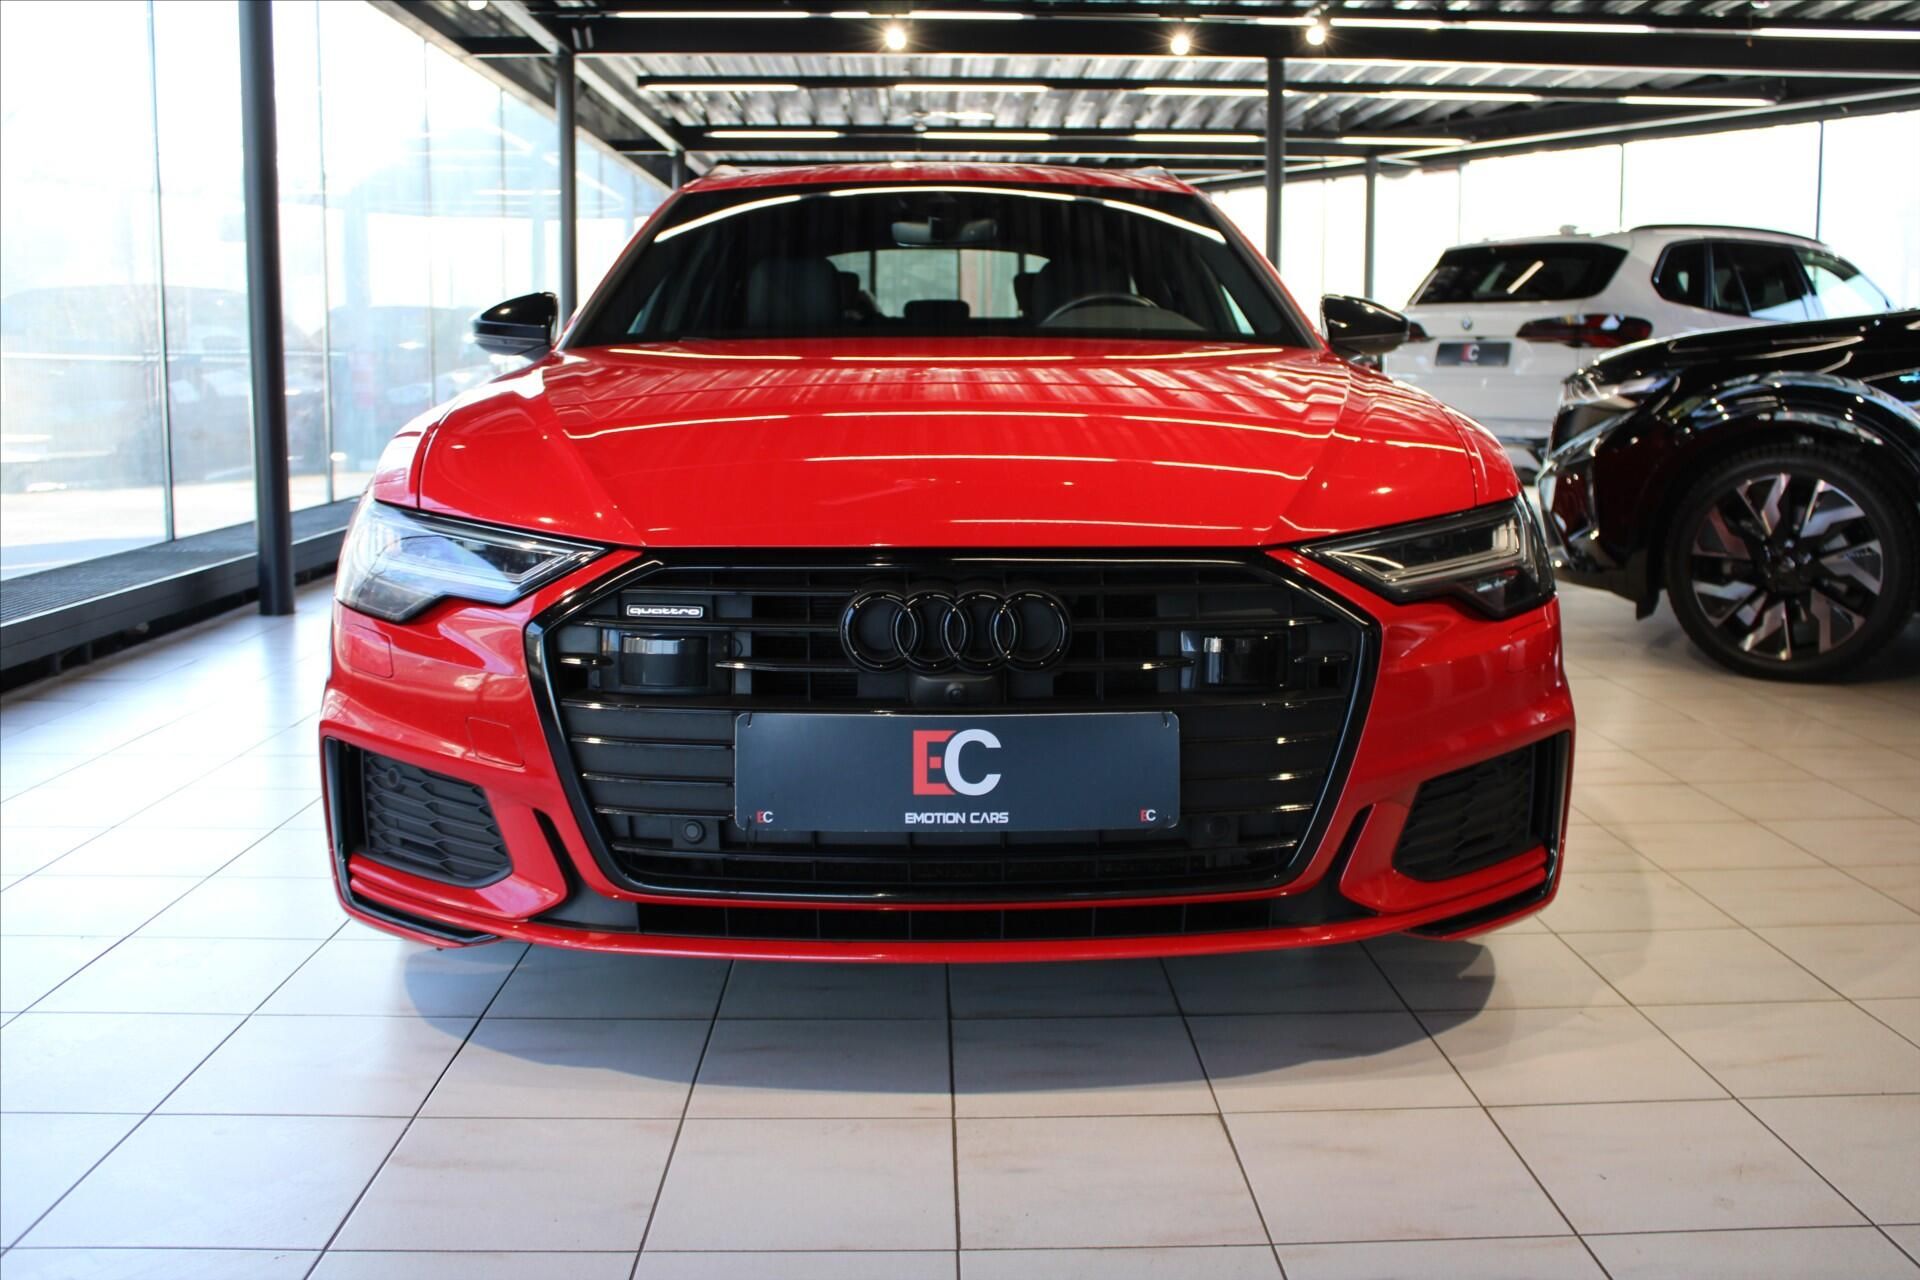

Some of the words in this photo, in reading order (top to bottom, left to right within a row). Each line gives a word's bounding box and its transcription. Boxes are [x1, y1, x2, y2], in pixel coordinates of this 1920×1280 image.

[629, 607, 700, 616] quattro
[913, 729, 1001, 796] EC
[756, 810, 774, 823] EC
[905, 812, 966, 824] EMOTION
[970, 812, 1009, 824] CARS
[1140, 809, 1157, 822] EC
